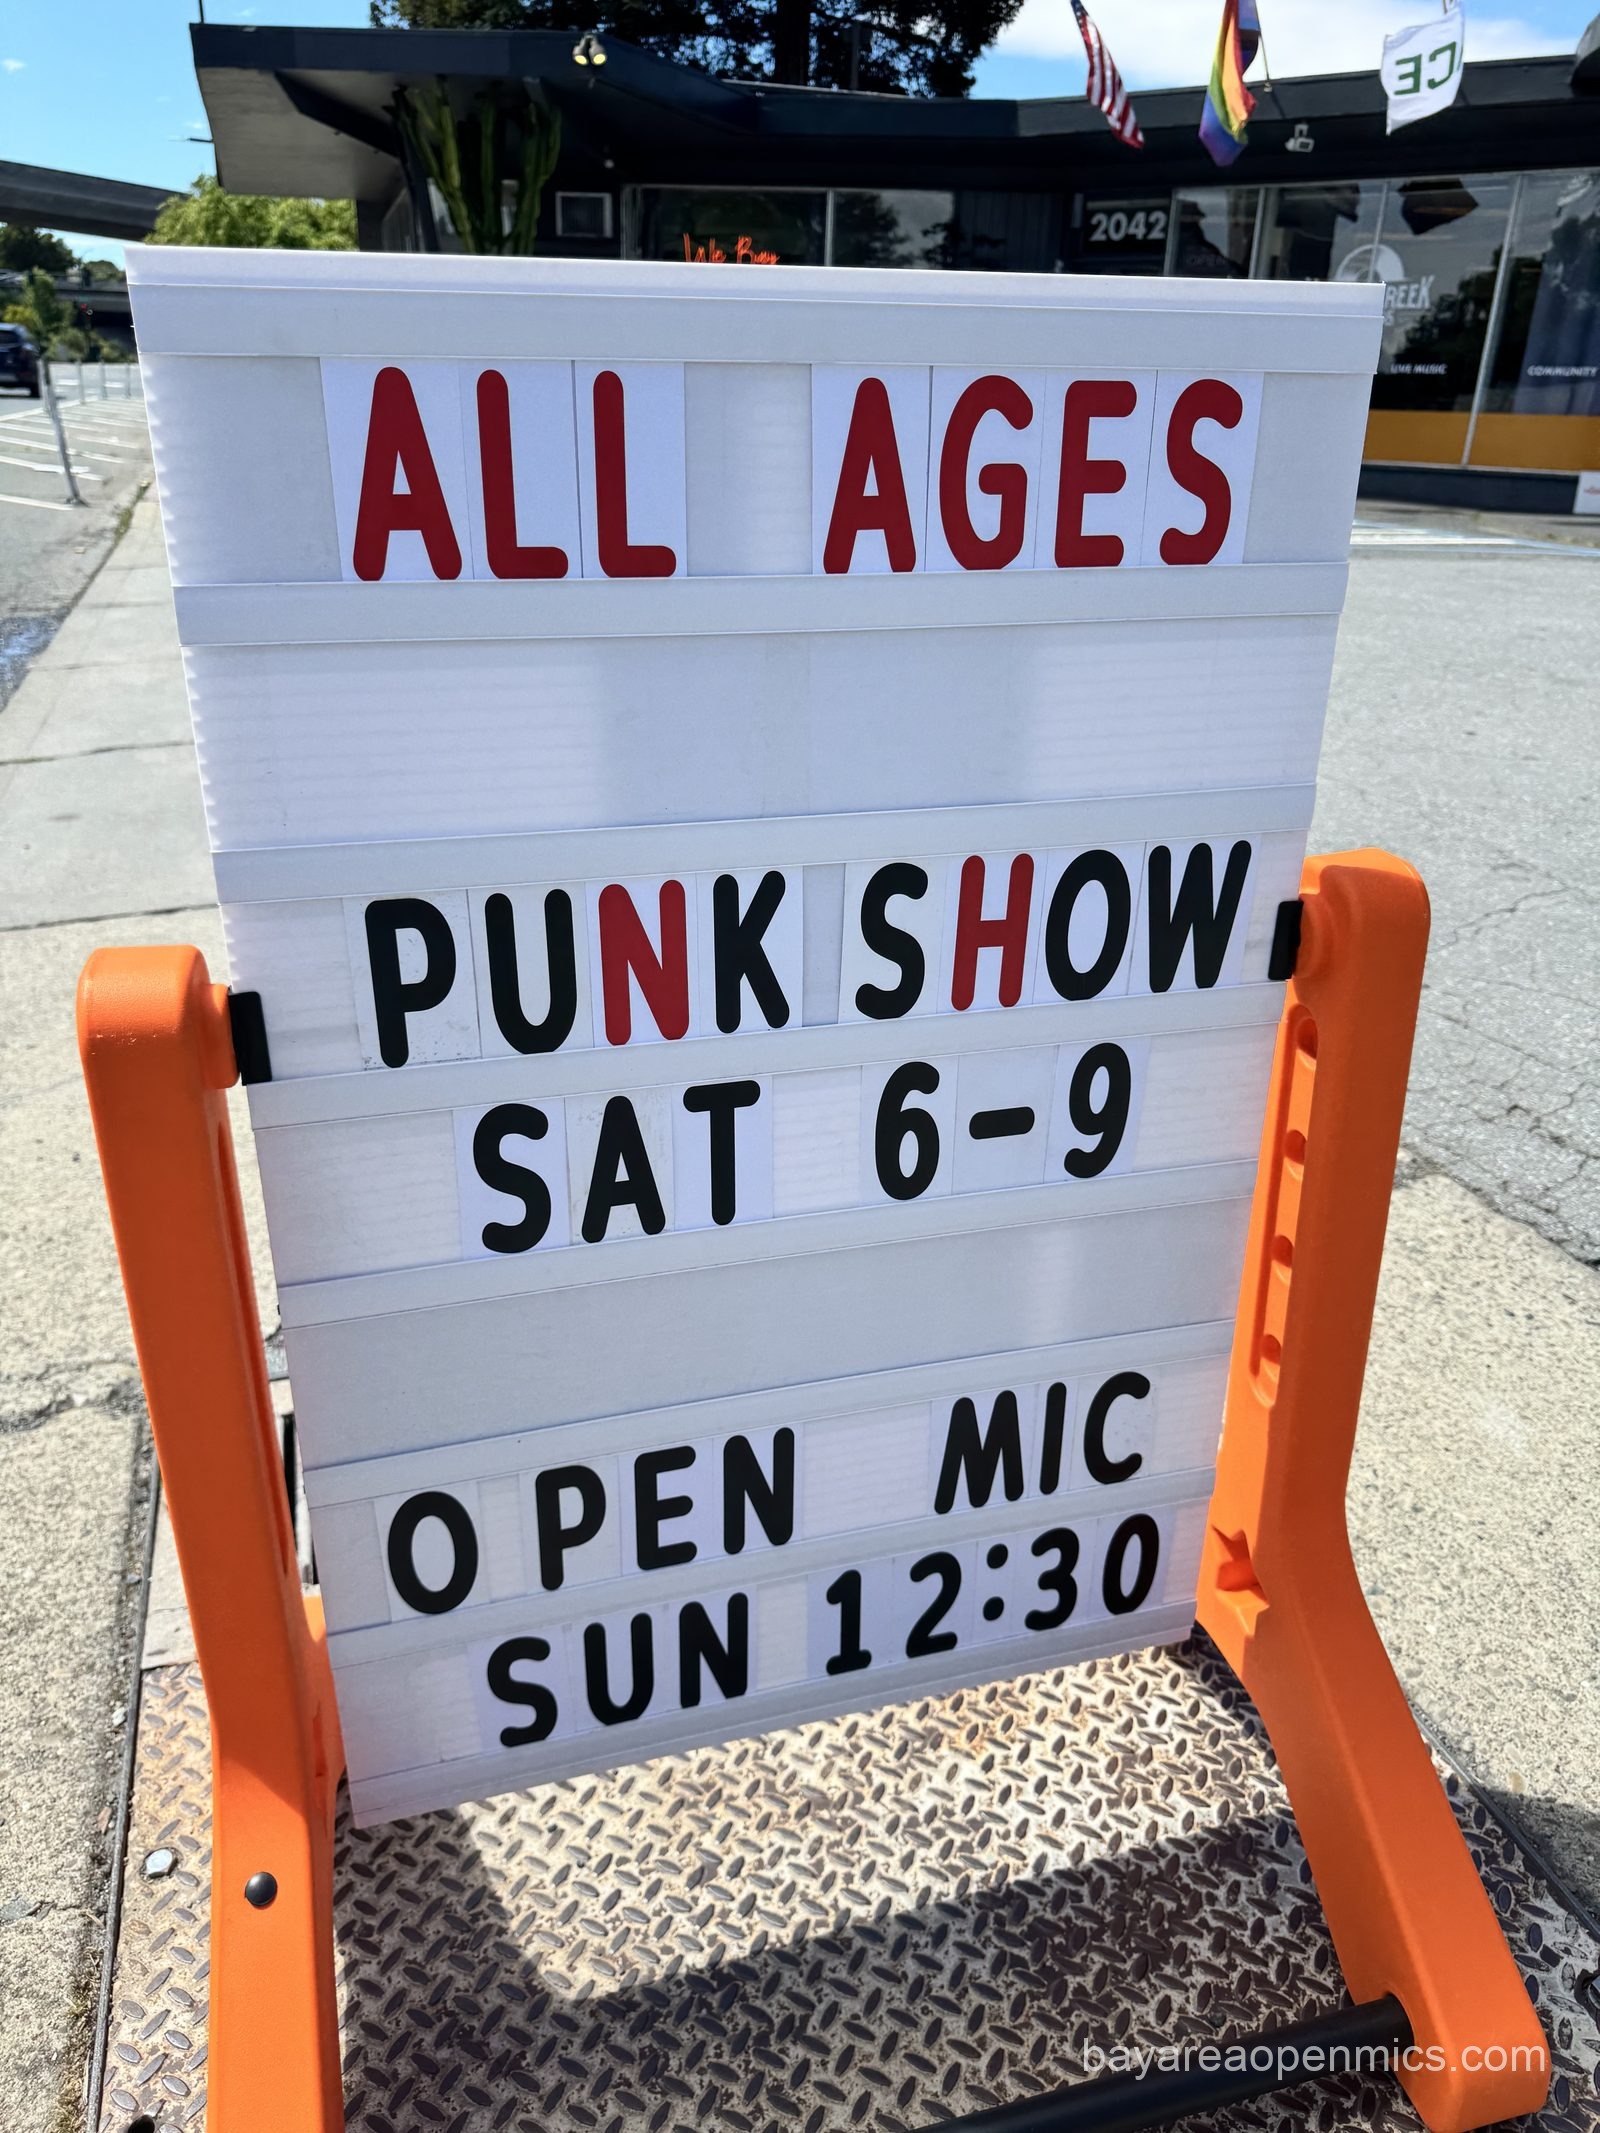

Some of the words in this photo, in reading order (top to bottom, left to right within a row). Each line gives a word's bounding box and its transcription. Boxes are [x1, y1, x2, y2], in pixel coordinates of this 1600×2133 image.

[1089, 210, 1168, 242] 2042
[1384, 275, 1435, 309] REEK
[353, 367, 676, 581] ALL
[824, 375, 1242, 574] AGES
[1413, 364, 1448, 375] MUSIC
[1527, 365, 1598, 377] COMMUNITY
[365, 871, 789, 1068] PUNK
[856, 840, 1251, 1020] SHOW
[473, 1080, 760, 1253] SAT
[875, 1043, 1131, 1200] 6-9
[388, 1428, 794, 1615] OPEN
[934, 1372, 1150, 1514] MIC
[487, 1593, 748, 1748] SUN
[826, 1514, 1159, 1676] 12:30
